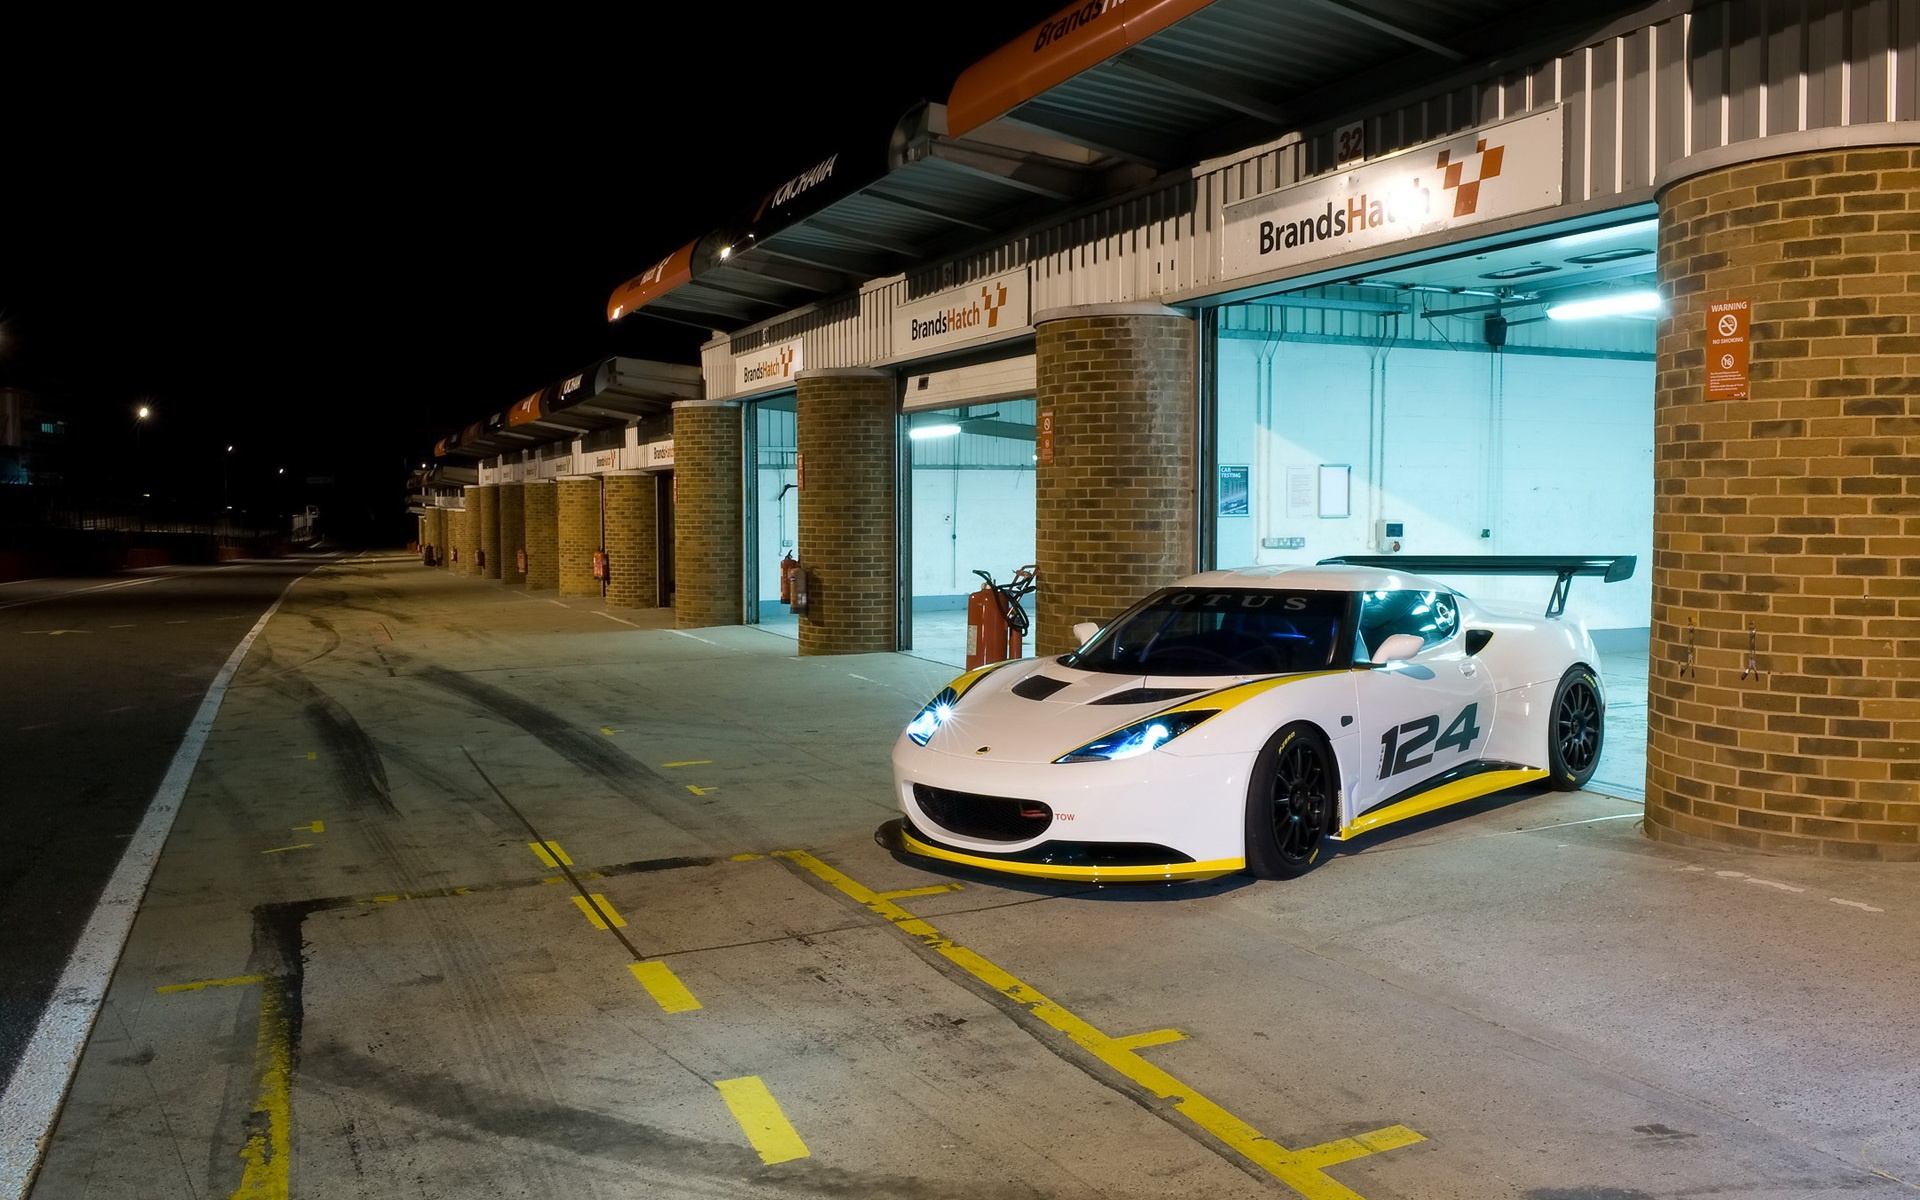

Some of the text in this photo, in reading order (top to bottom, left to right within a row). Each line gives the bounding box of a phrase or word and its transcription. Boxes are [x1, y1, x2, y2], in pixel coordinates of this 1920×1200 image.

[1338, 127, 1363, 162] 32
[1711, 301, 1747, 313] WARNING
[911, 301, 980, 341] BrandsHatch
[1720, 336, 1744, 345] SMOKING
[744, 357, 780, 383] BrandsHatch
[1379, 702, 1481, 781] 124
[1055, 813, 1075, 821] TOW
